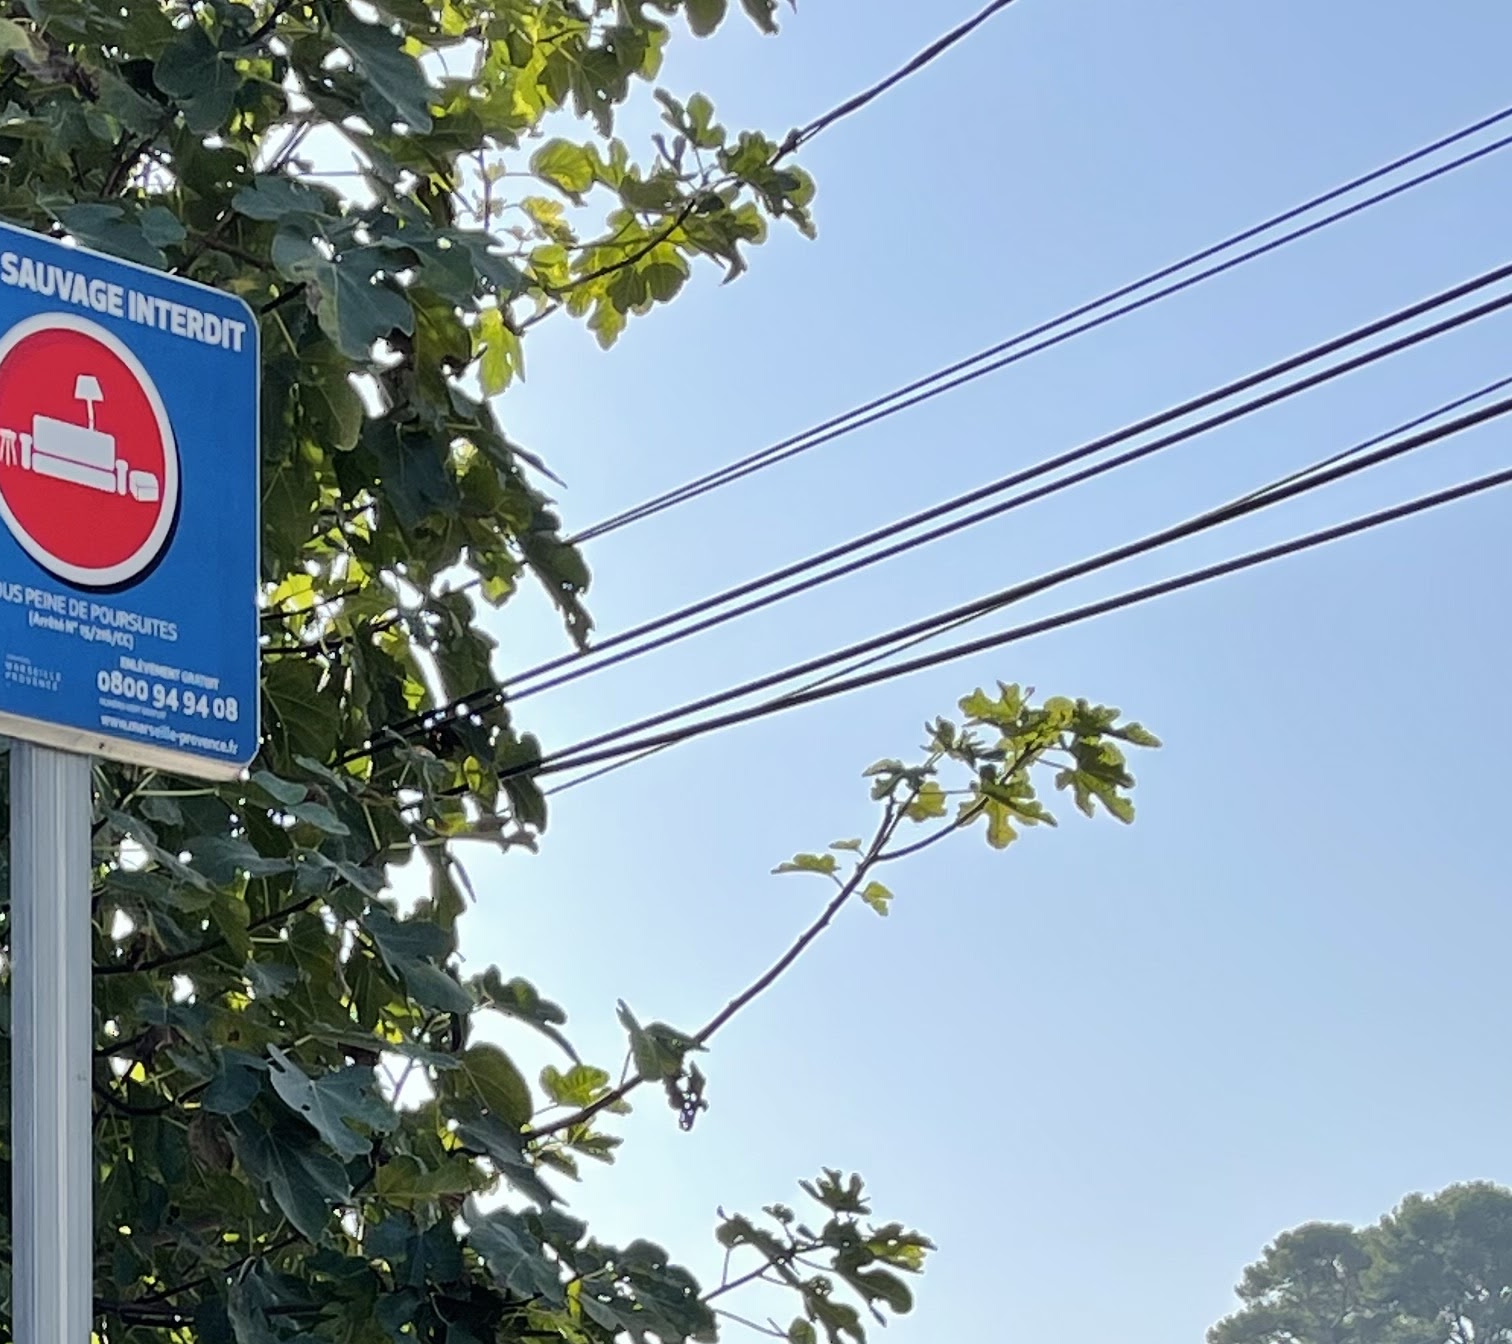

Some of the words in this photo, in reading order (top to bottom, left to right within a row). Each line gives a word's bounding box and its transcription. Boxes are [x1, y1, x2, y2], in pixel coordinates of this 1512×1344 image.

[0, 252, 124, 318] SAUVAGE
[128, 290, 247, 352] INTERDIT
[25, 587, 67, 616] PEINE
[68, 595, 88, 620] DE
[90, 602, 178, 642] POURSUITES
[97, 670, 148, 701] 0800
[152, 683, 179, 712] 94
[183, 690, 209, 719] 94
[213, 697, 238, 721] 08
